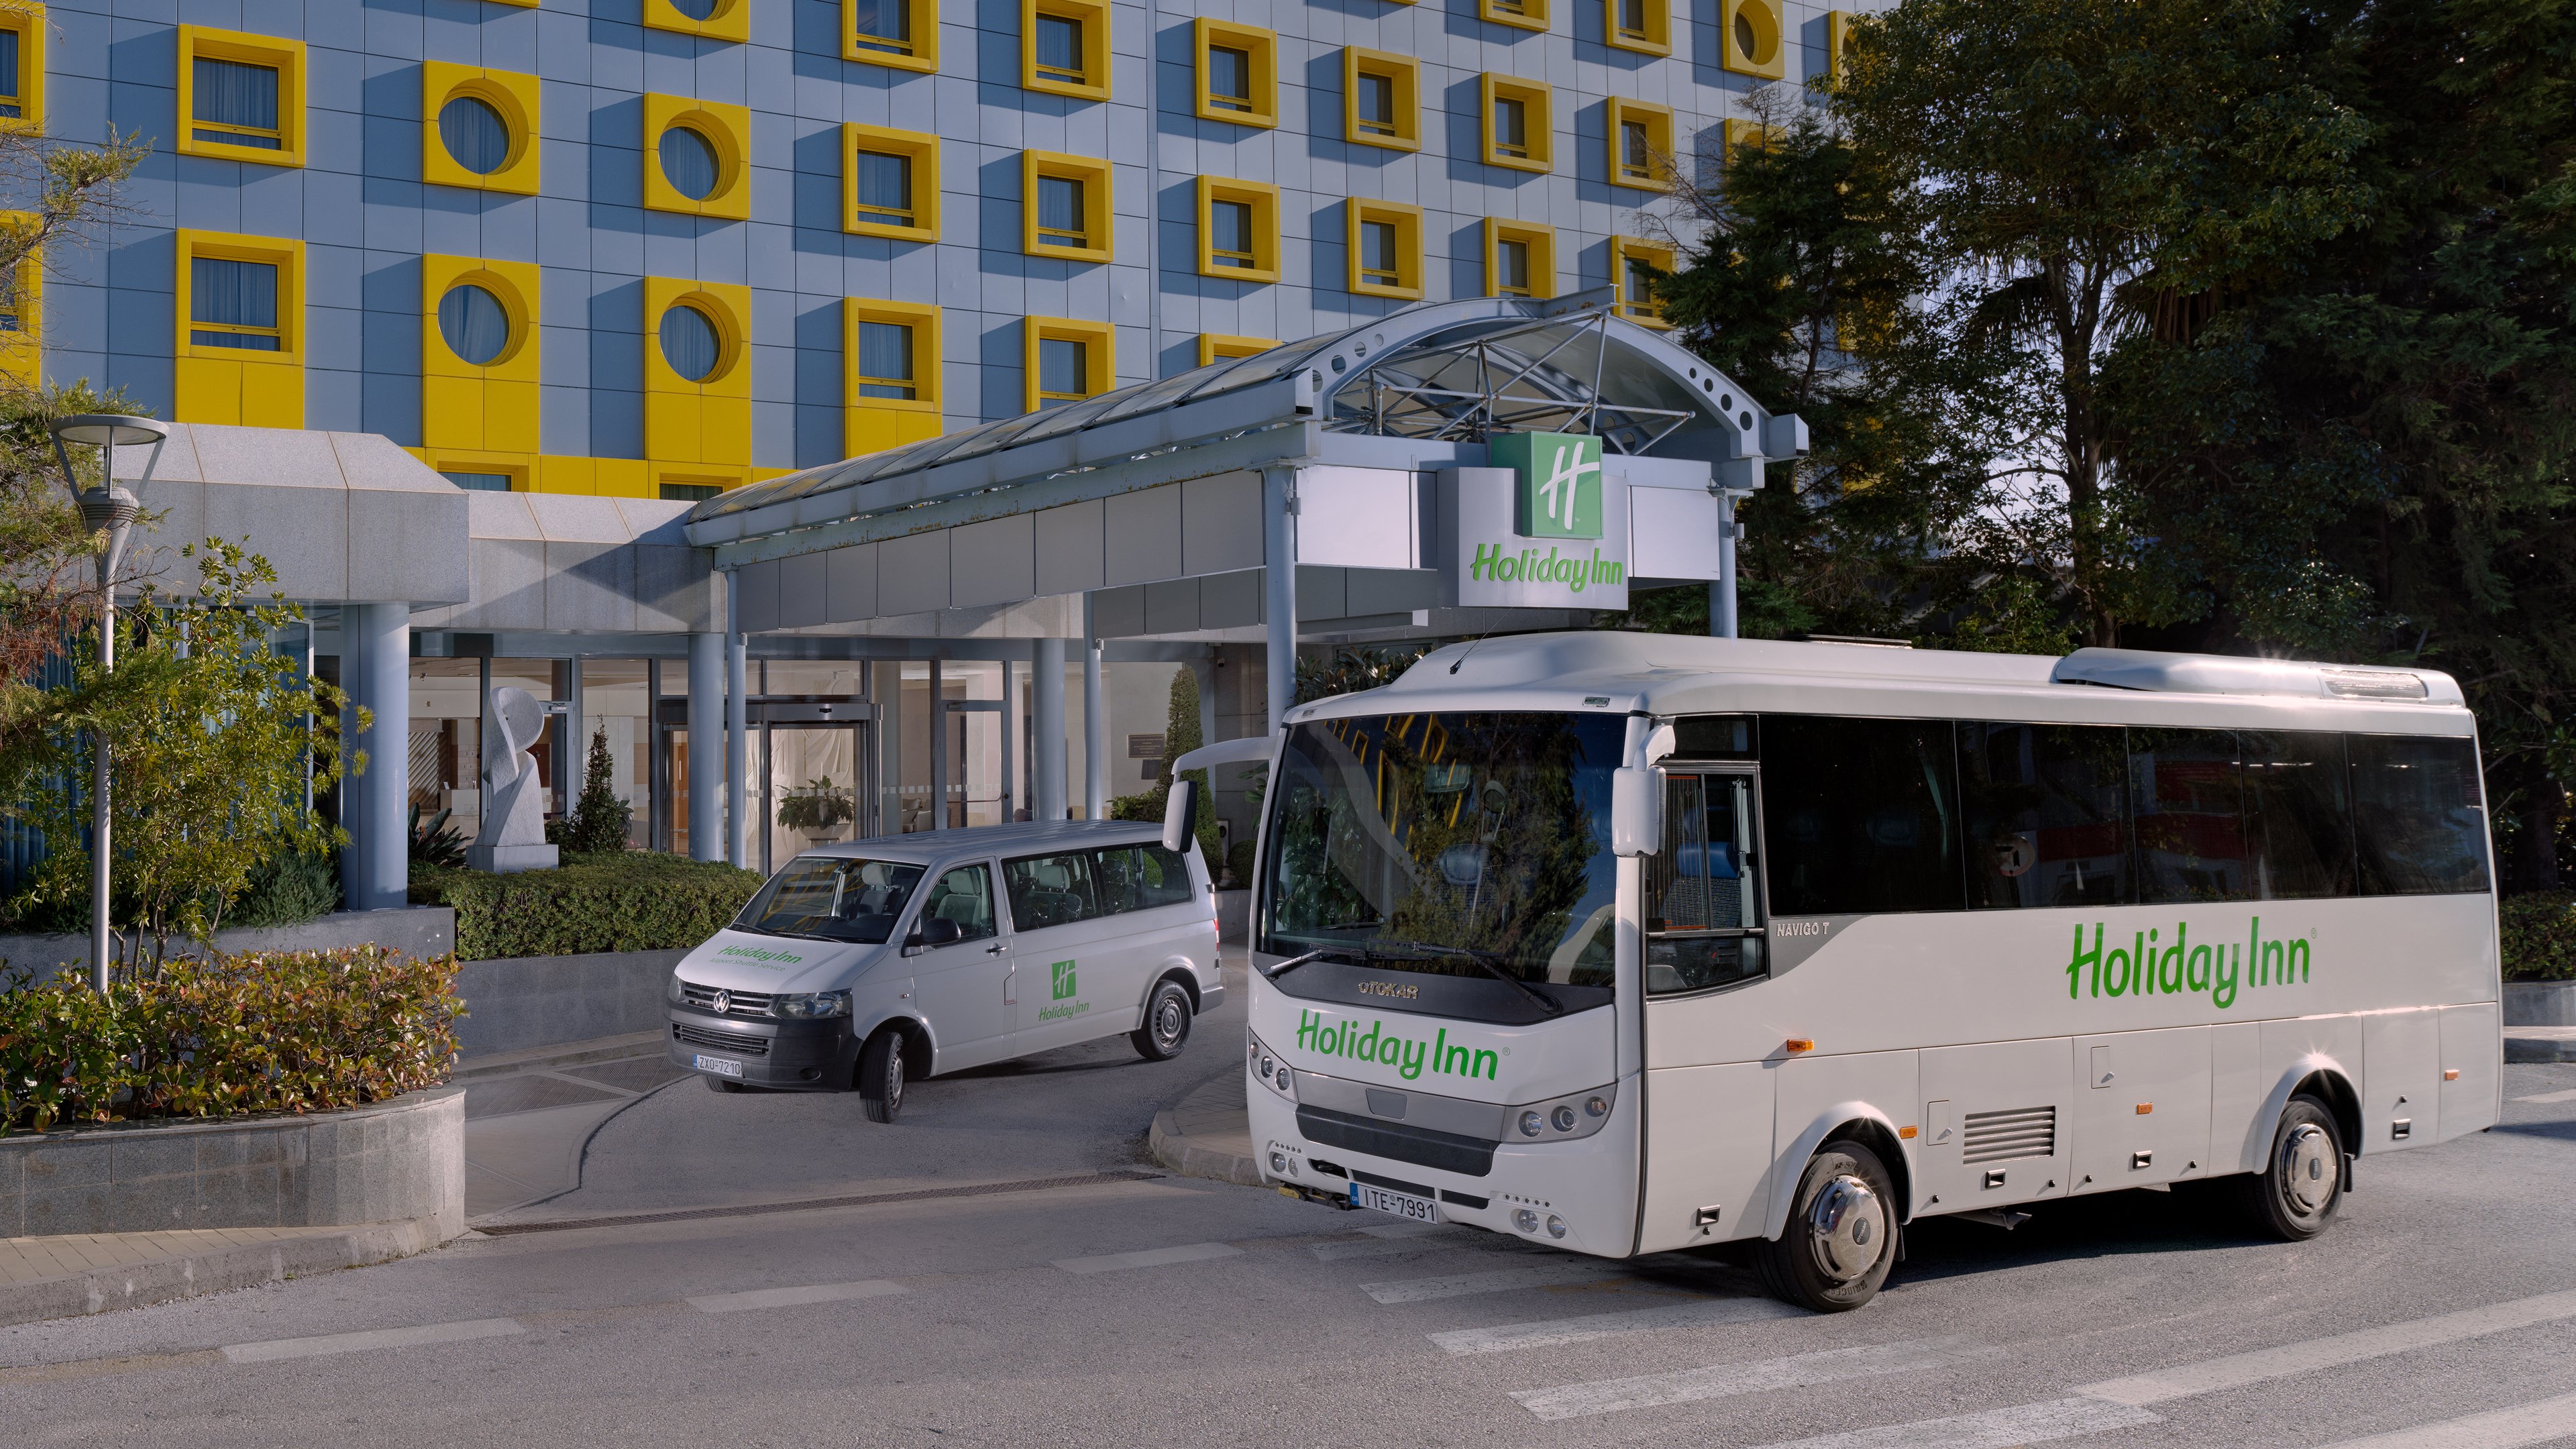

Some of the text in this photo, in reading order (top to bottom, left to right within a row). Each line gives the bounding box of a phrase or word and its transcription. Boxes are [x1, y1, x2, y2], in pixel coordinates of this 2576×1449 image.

[1470, 543, 1623, 592] Holiday Inn
[1776, 922, 1830, 936] NAVIGO T
[717, 945, 802, 964] Holiday Inn
[733, 959, 759, 967] Shuttle
[758, 962, 786, 972] Service
[2066, 916, 2310, 1009] Holiday Inn
[1358, 981, 1419, 1000] OTOKAR
[1038, 1000, 1089, 1022] Holiday Inn
[1297, 1008, 1499, 1081] Holiday Inn
[1364, 1189, 1435, 1222] ITE-7991
